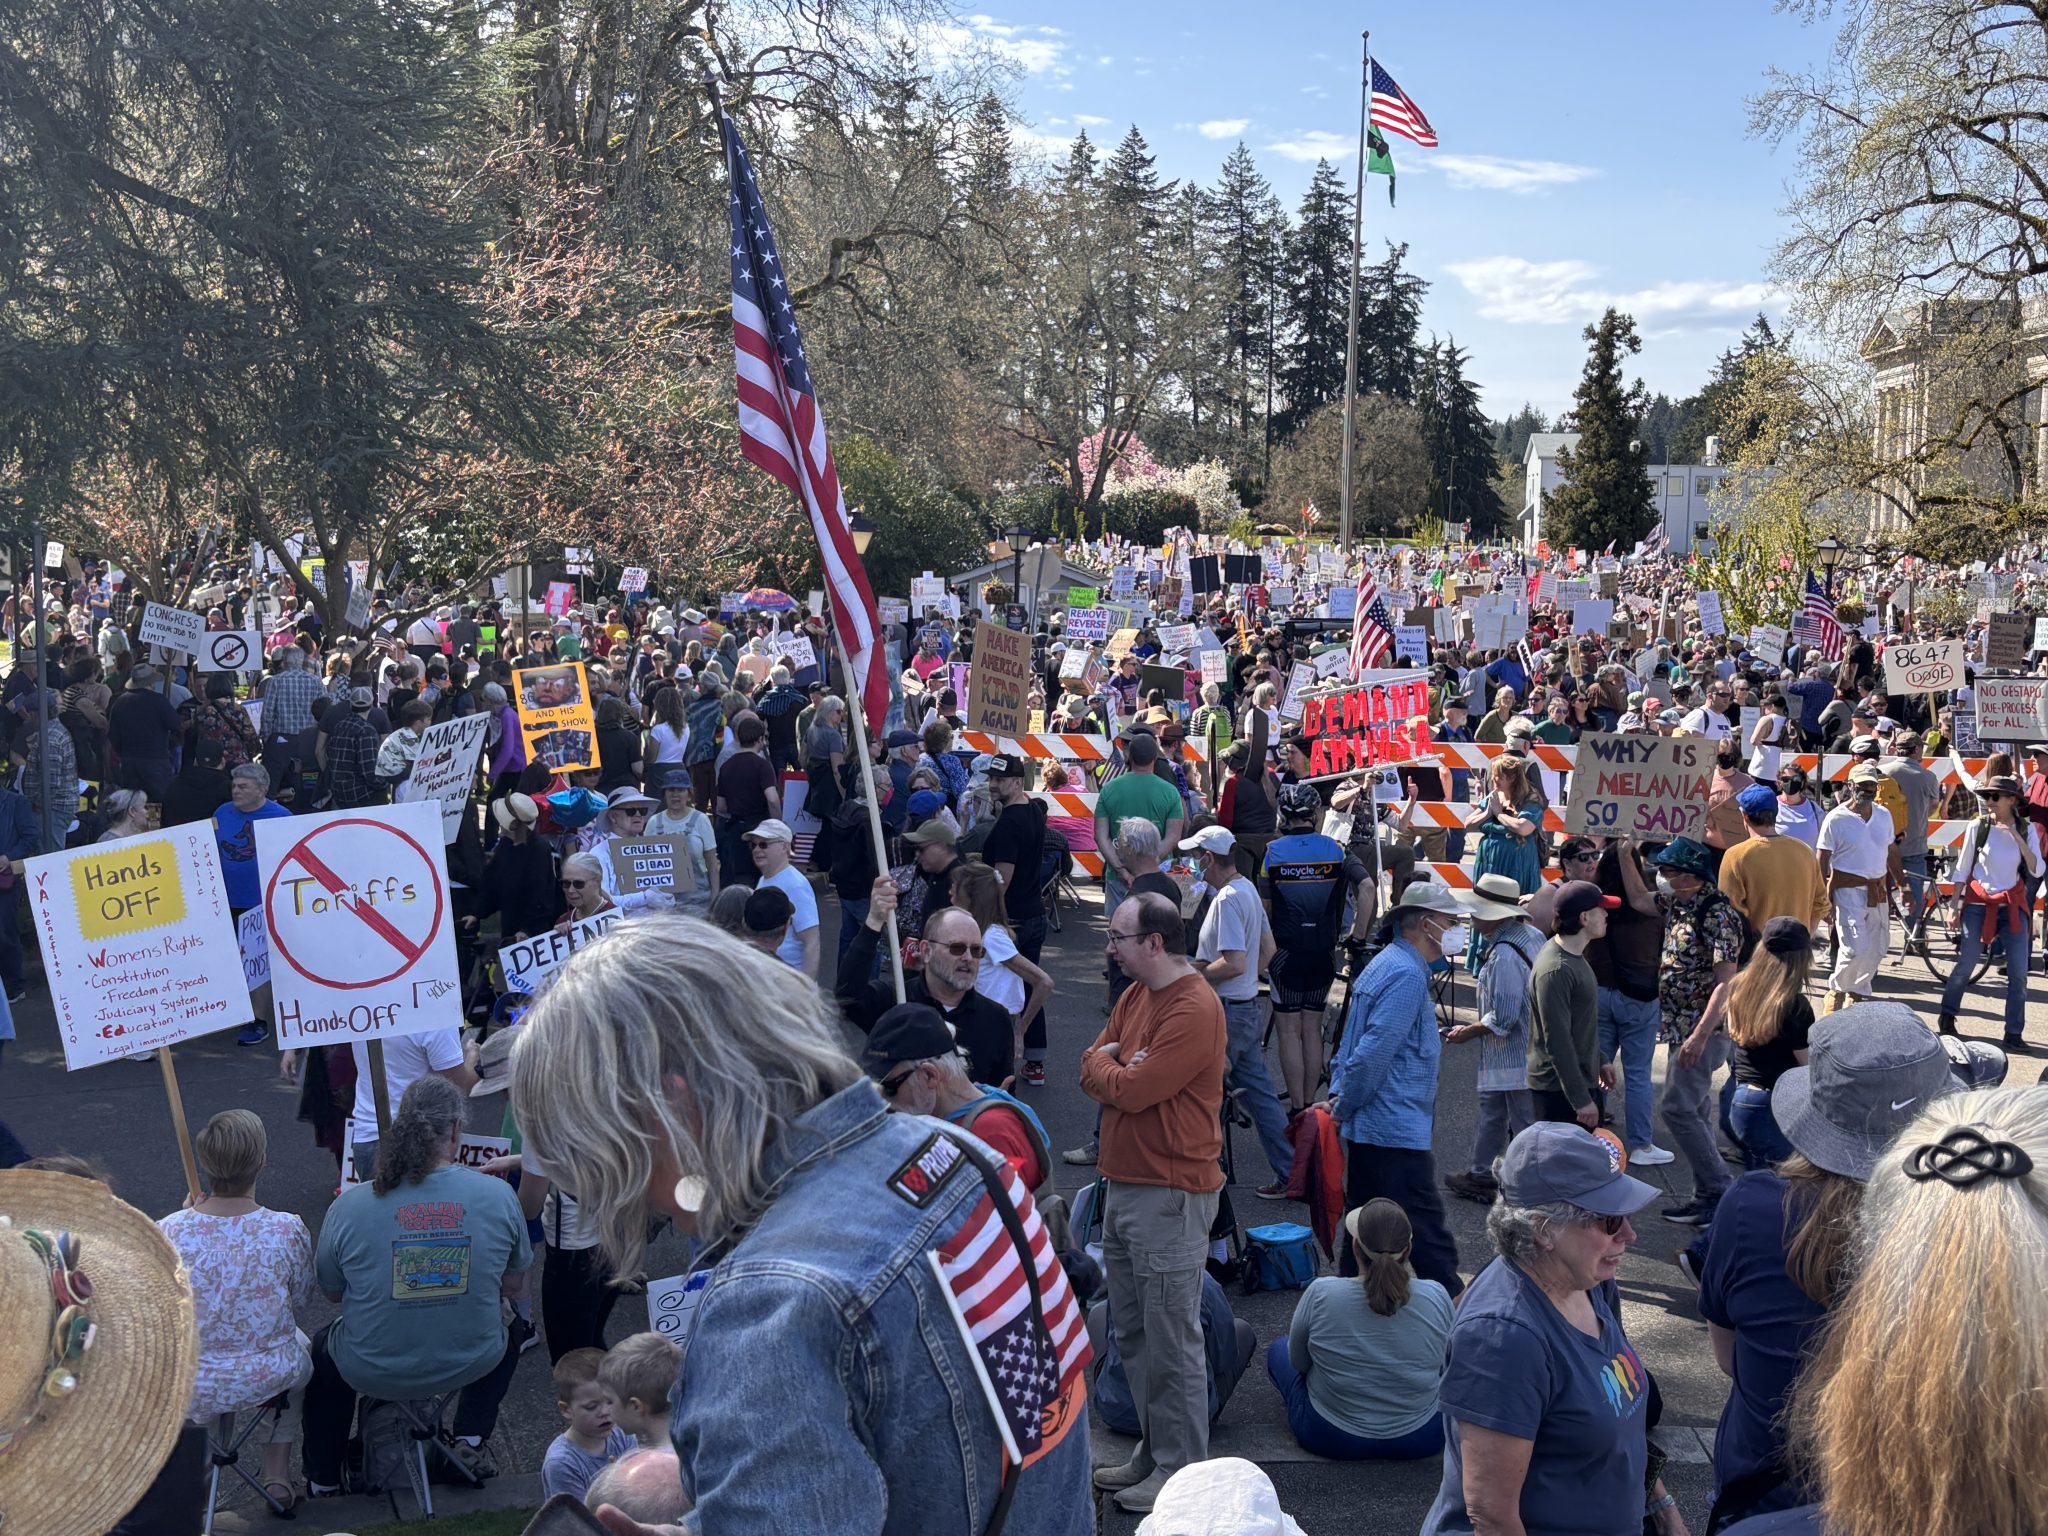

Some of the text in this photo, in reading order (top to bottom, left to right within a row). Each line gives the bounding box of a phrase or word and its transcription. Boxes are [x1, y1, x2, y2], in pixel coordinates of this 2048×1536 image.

[147, 605, 199, 629] CONGRESS
[1068, 618, 1107, 629] REVERSE
[1070, 608, 1107, 619] REMOVE
[142, 631, 166, 644] LIMIT
[156, 621, 173, 634] YOUR
[174, 627, 186, 637] JOB
[188, 630, 197, 640] TO
[986, 629, 1019, 656] MAKE
[1067, 628, 1104, 639] RECLAIM
[980, 652, 1024, 680] AMERICA
[981, 674, 1020, 710] KIND
[1980, 685, 1996, 697] NO
[535, 706, 575, 718] AND HIS
[1304, 681, 1430, 738] DEMAND
[1981, 702, 2037, 715] DUE-PROCESS
[561, 717, 588, 728] SHOW
[980, 709, 1017, 733] AGAIN
[1982, 716, 2001, 728] for
[421, 720, 467, 755] MAGA
[1310, 720, 1434, 777] AHIMSA
[1590, 739, 1697, 767] WHY IS
[1596, 771, 1711, 802] MELANIA
[1585, 800, 1619, 826] SO
[1634, 803, 1701, 834] SAD?
[623, 844, 670, 855] CRUELTY
[83, 853, 162, 891] Hands
[635, 860, 671, 870] IS BAD
[1280, 866, 1315, 877] bicycle
[636, 875, 672, 887] POLICY
[101, 886, 161, 921] OFF
[280, 876, 418, 917] Tariffs
[242, 908, 265, 939] PRO
[87, 934, 205, 969] Womens Rights
[91, 966, 170, 988] Constitution
[243, 951, 270, 981] CONST
[106, 974, 209, 1003] Freedom of Speech
[59, 994, 78, 1044] LGBTQ
[97, 994, 199, 1021] Judiciary System
[102, 999, 228, 1039] Education History
[106, 1028, 188, 1056] Legal immigrants
[455, 1144, 509, 1167] RISY
[896, 1181, 920, 1202] I
[398, 1202, 464, 1224] KAUAI
[404, 1215, 460, 1231] COFFEE
